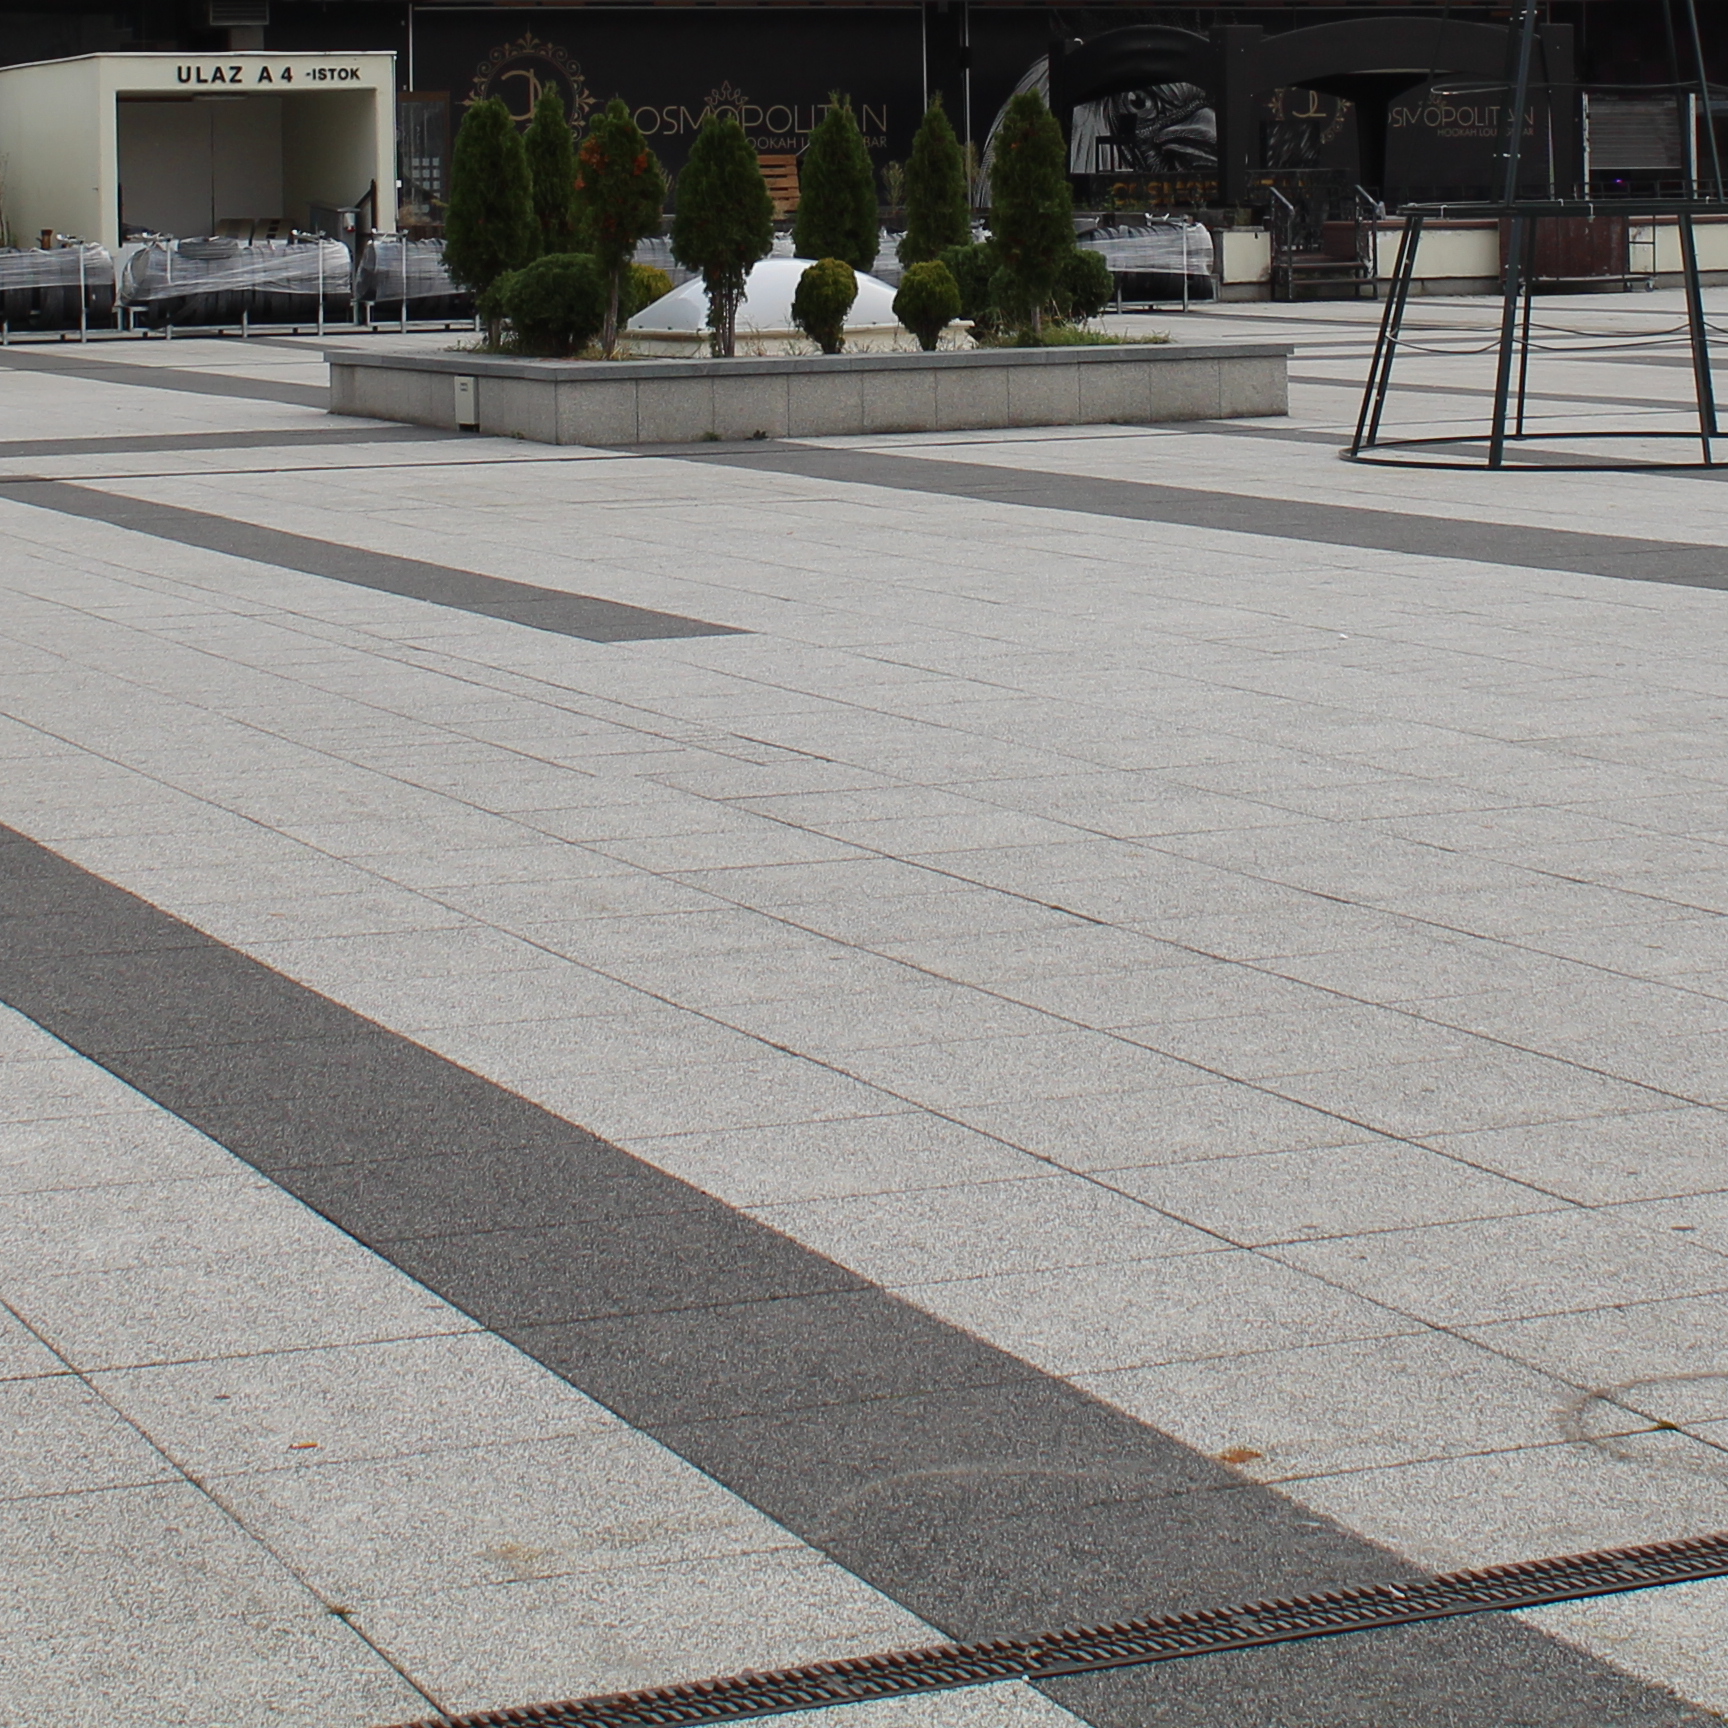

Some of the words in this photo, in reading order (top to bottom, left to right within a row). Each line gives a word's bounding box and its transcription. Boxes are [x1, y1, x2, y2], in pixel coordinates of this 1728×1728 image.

[177, 65, 243, 84] ULAZ
[305, 67, 361, 81] -ISTOK
[633, 103, 888, 136] OSMOPOLITN
[1437, 127, 1477, 138] HOOKAH
[746, 136, 797, 150] OOKAH
[863, 135, 888, 149] BAR
